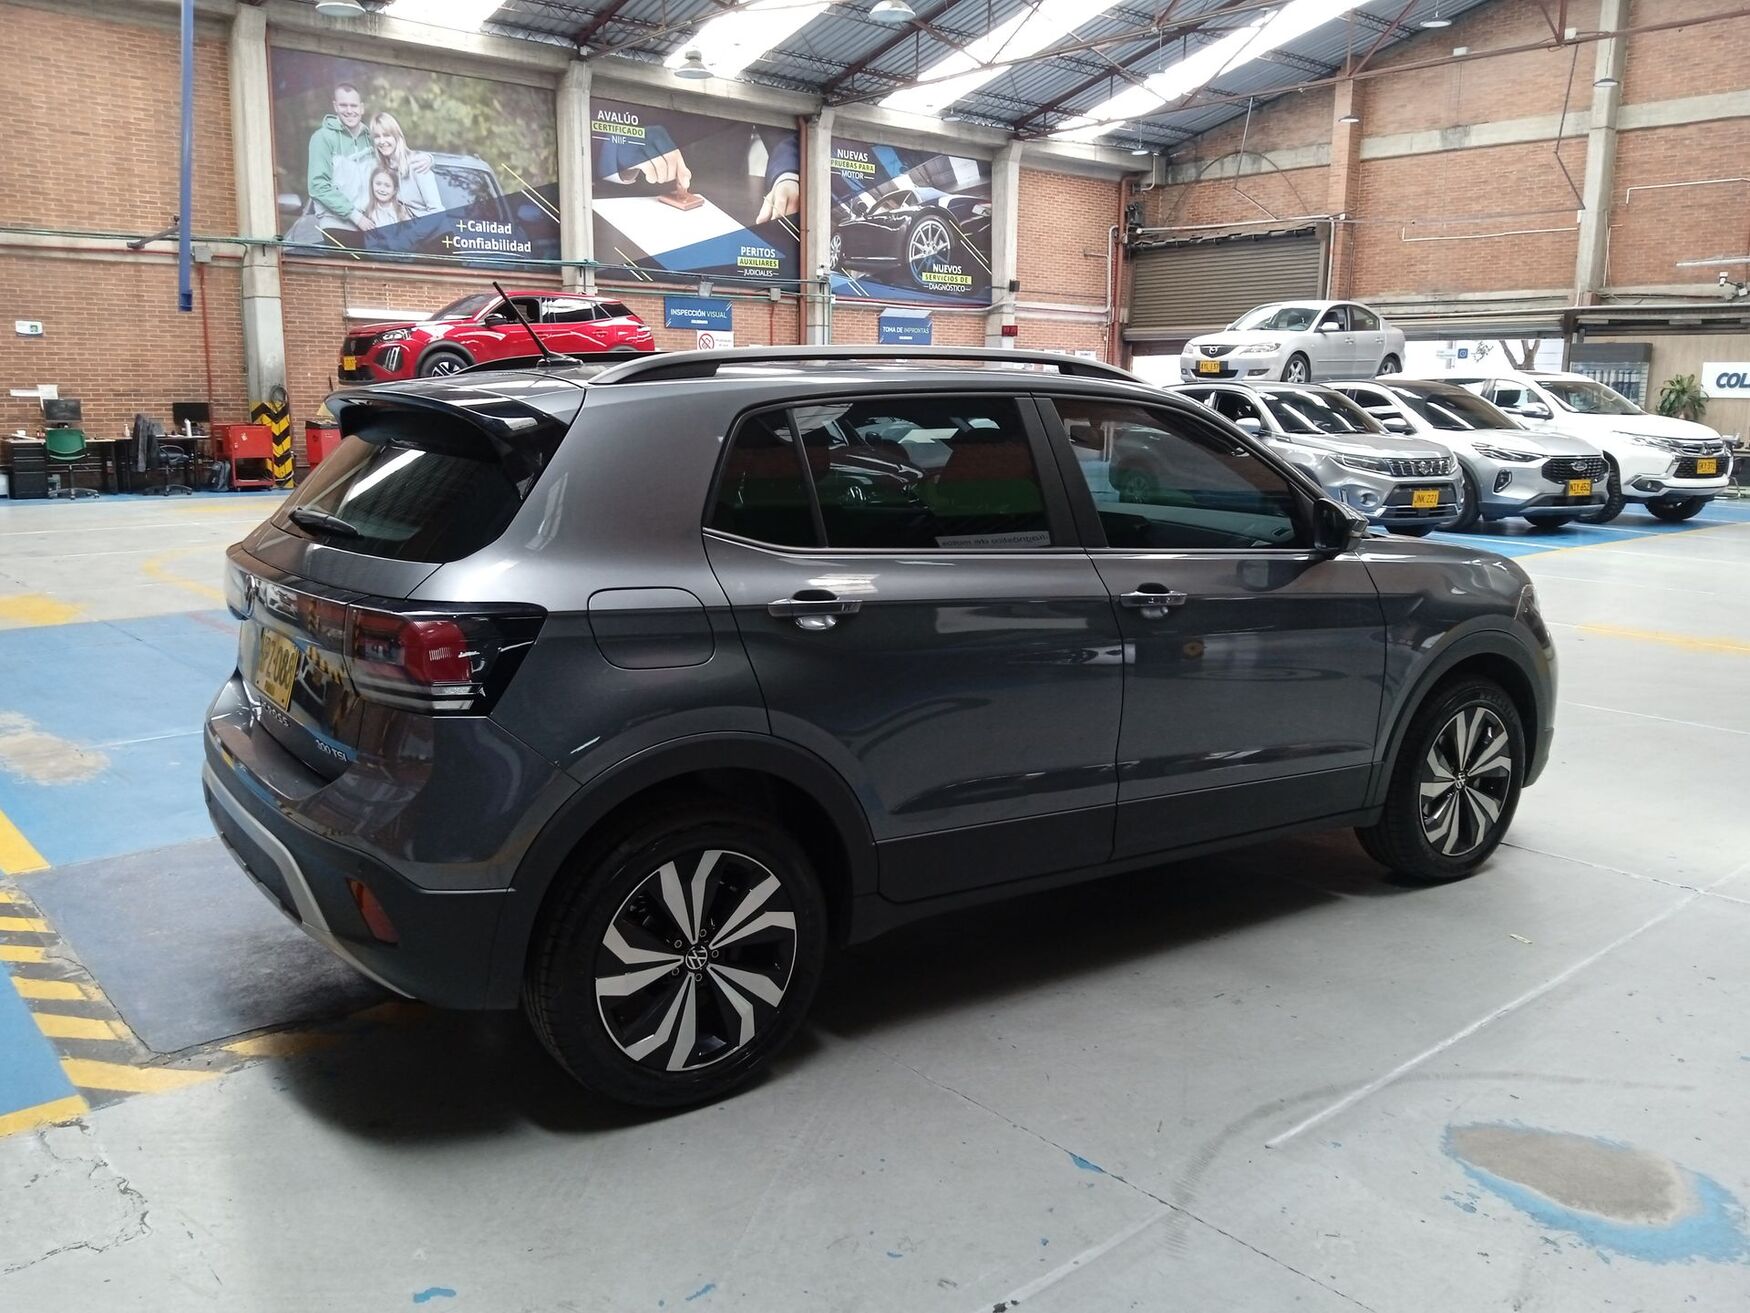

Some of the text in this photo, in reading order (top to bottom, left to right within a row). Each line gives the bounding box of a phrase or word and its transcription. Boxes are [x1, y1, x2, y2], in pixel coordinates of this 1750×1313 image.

[597, 109, 639, 126] AVALÚO
[592, 122, 644, 137] CERTIFICADO
[611, 135, 627, 145] NIIF
[837, 149, 869, 162] NUEVAS
[830, 159, 874, 172] PRUEBAS PARA
[841, 170, 864, 180] MOTOR
[740, 246, 776, 258] PERITOS
[740, 257, 778, 267] AUXILIARES
[743, 269, 774, 277] JUDICIALES
[932, 263, 963, 275] NUEVOS
[925, 273, 958, 283] SERVICIOS
[928, 282, 966, 293] DIAGNÓSTICO
[670, 308, 728, 319] INSPECCIÓN VISUAL
[896, 326, 904, 334] DE
